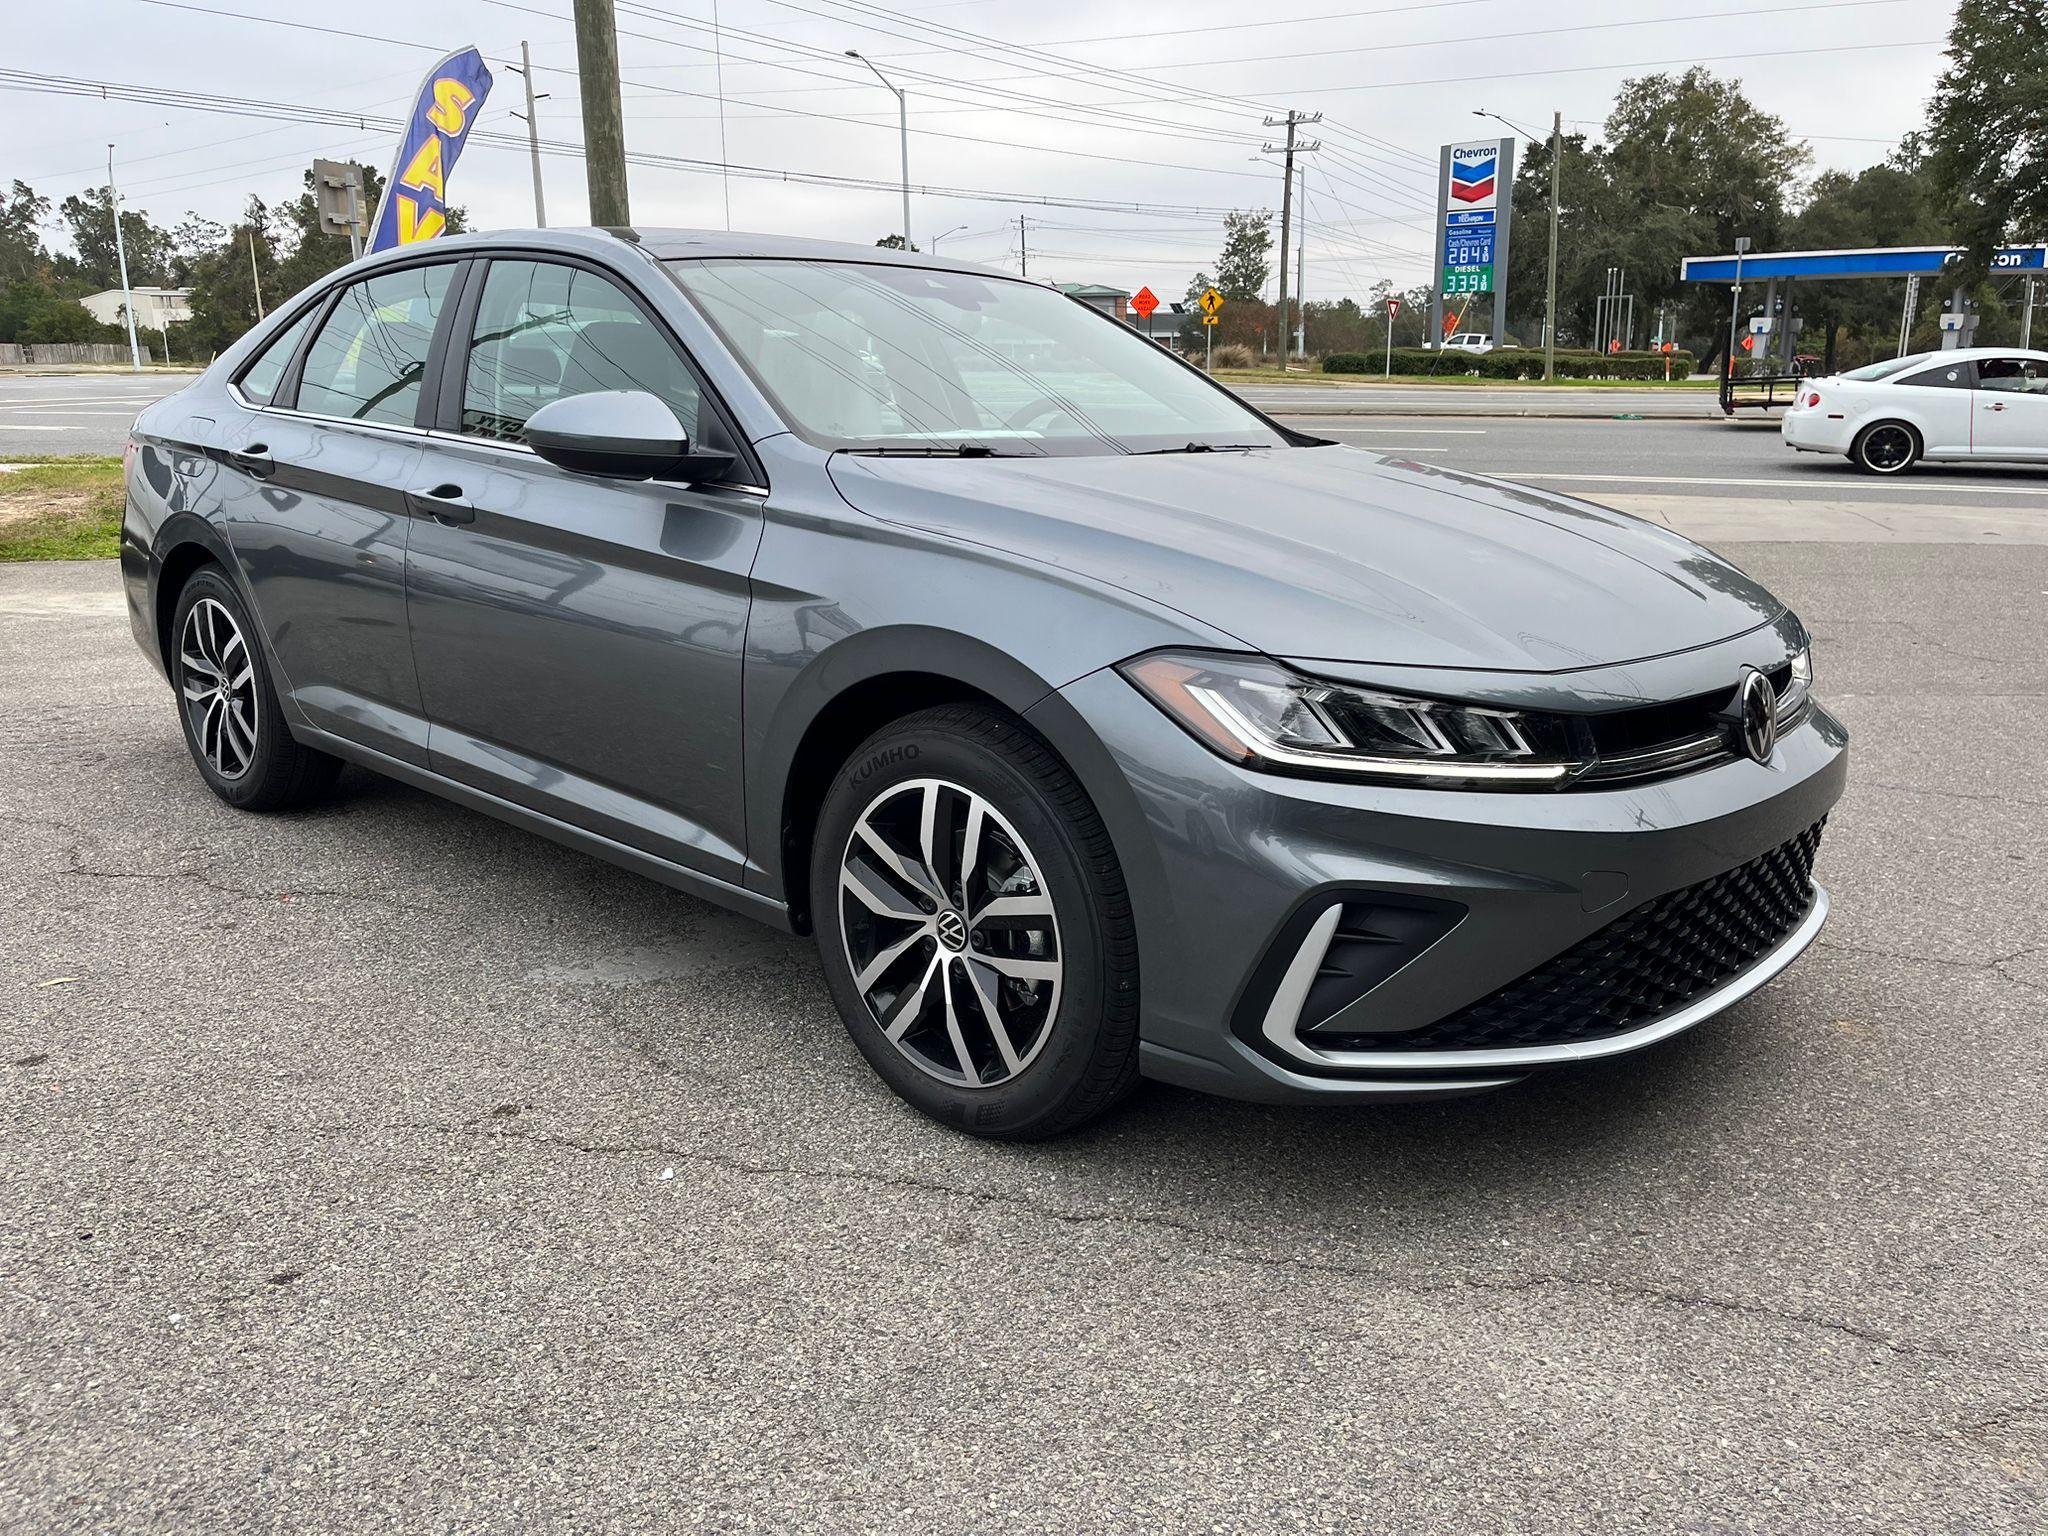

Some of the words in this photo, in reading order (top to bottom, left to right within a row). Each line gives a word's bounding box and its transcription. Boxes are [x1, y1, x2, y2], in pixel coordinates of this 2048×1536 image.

[1453, 146, 1497, 160] Chevron
[1454, 265, 1481, 273] DIESEL
[848, 743, 920, 791] KUMHO
